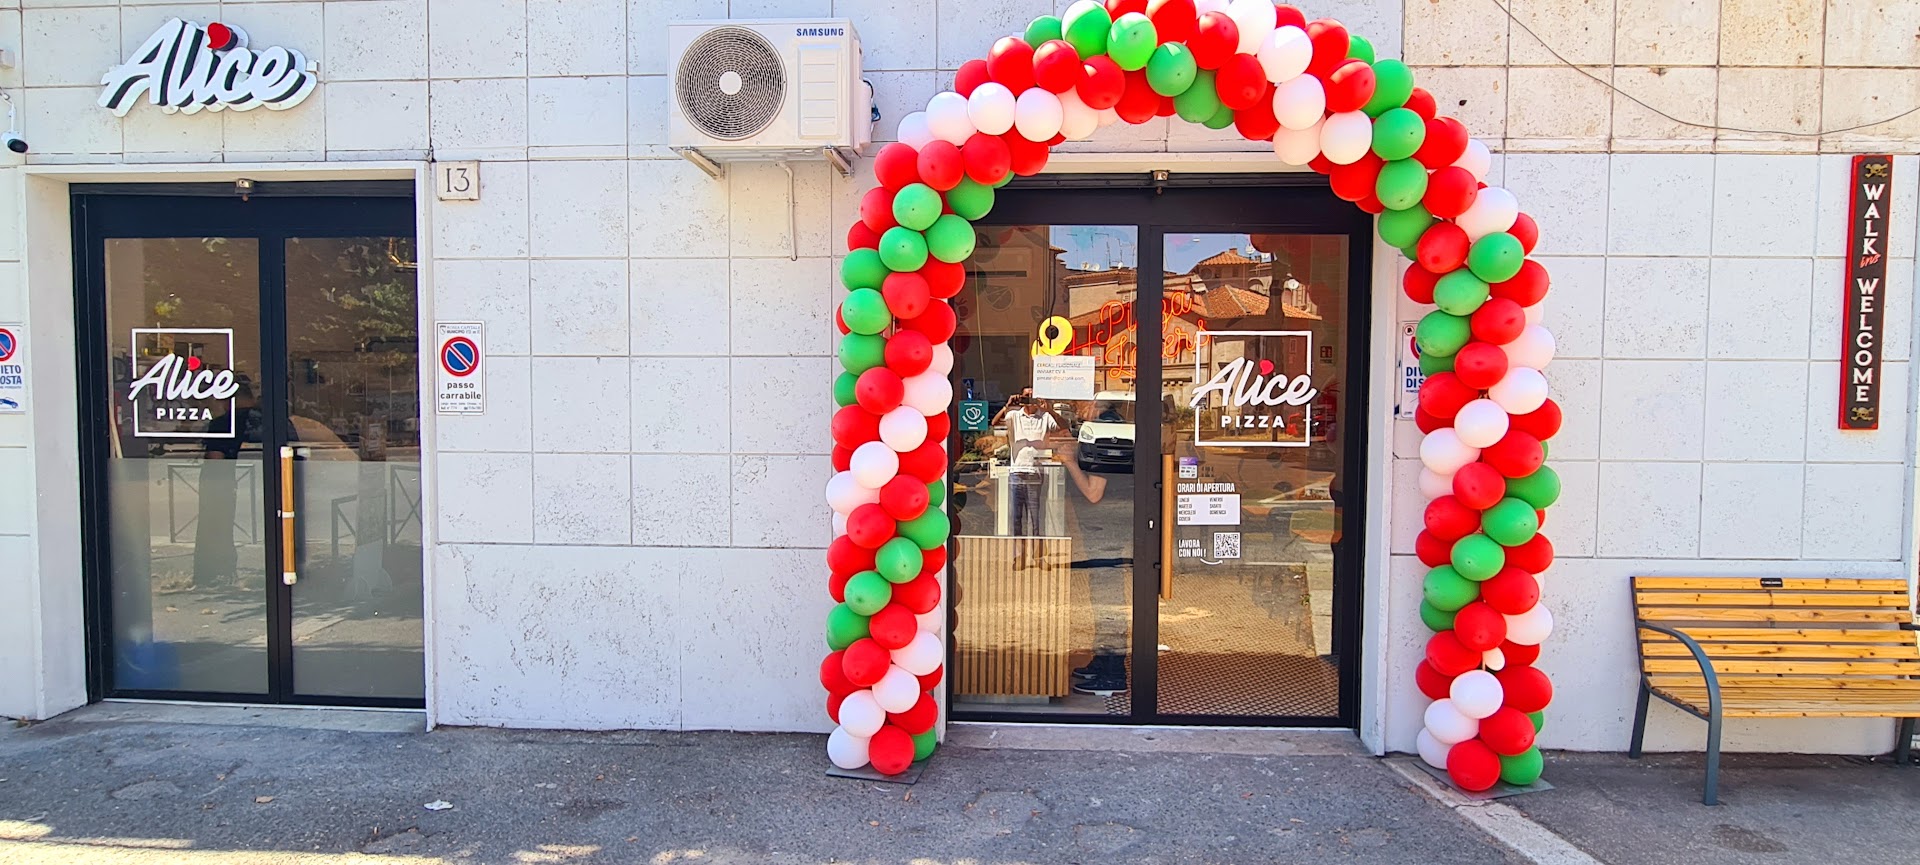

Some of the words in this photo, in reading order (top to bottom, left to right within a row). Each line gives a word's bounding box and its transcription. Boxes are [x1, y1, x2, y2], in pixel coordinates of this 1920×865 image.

[796, 28, 844, 37] SAMSUNG
[97, 17, 302, 109] Alice
[446, 168, 470, 192] 13
[1862, 183, 1886, 255] WALK
[1852, 278, 1880, 402] WELCOME
[128, 353, 240, 401] Alice
[1189, 356, 1318, 407] Alice
[447, 382, 474, 390] passo
[440, 391, 481, 399] carrabile
[156, 408, 213, 420] PIZZA
[1221, 415, 1285, 428] PIZZA
[1177, 483, 1196, 493] ORARI
[1196, 483, 1203, 493] DI
[1203, 482, 1236, 493] APERTURA
[1178, 539, 1200, 548] LAVORA
[1178, 548, 1191, 558] CON
